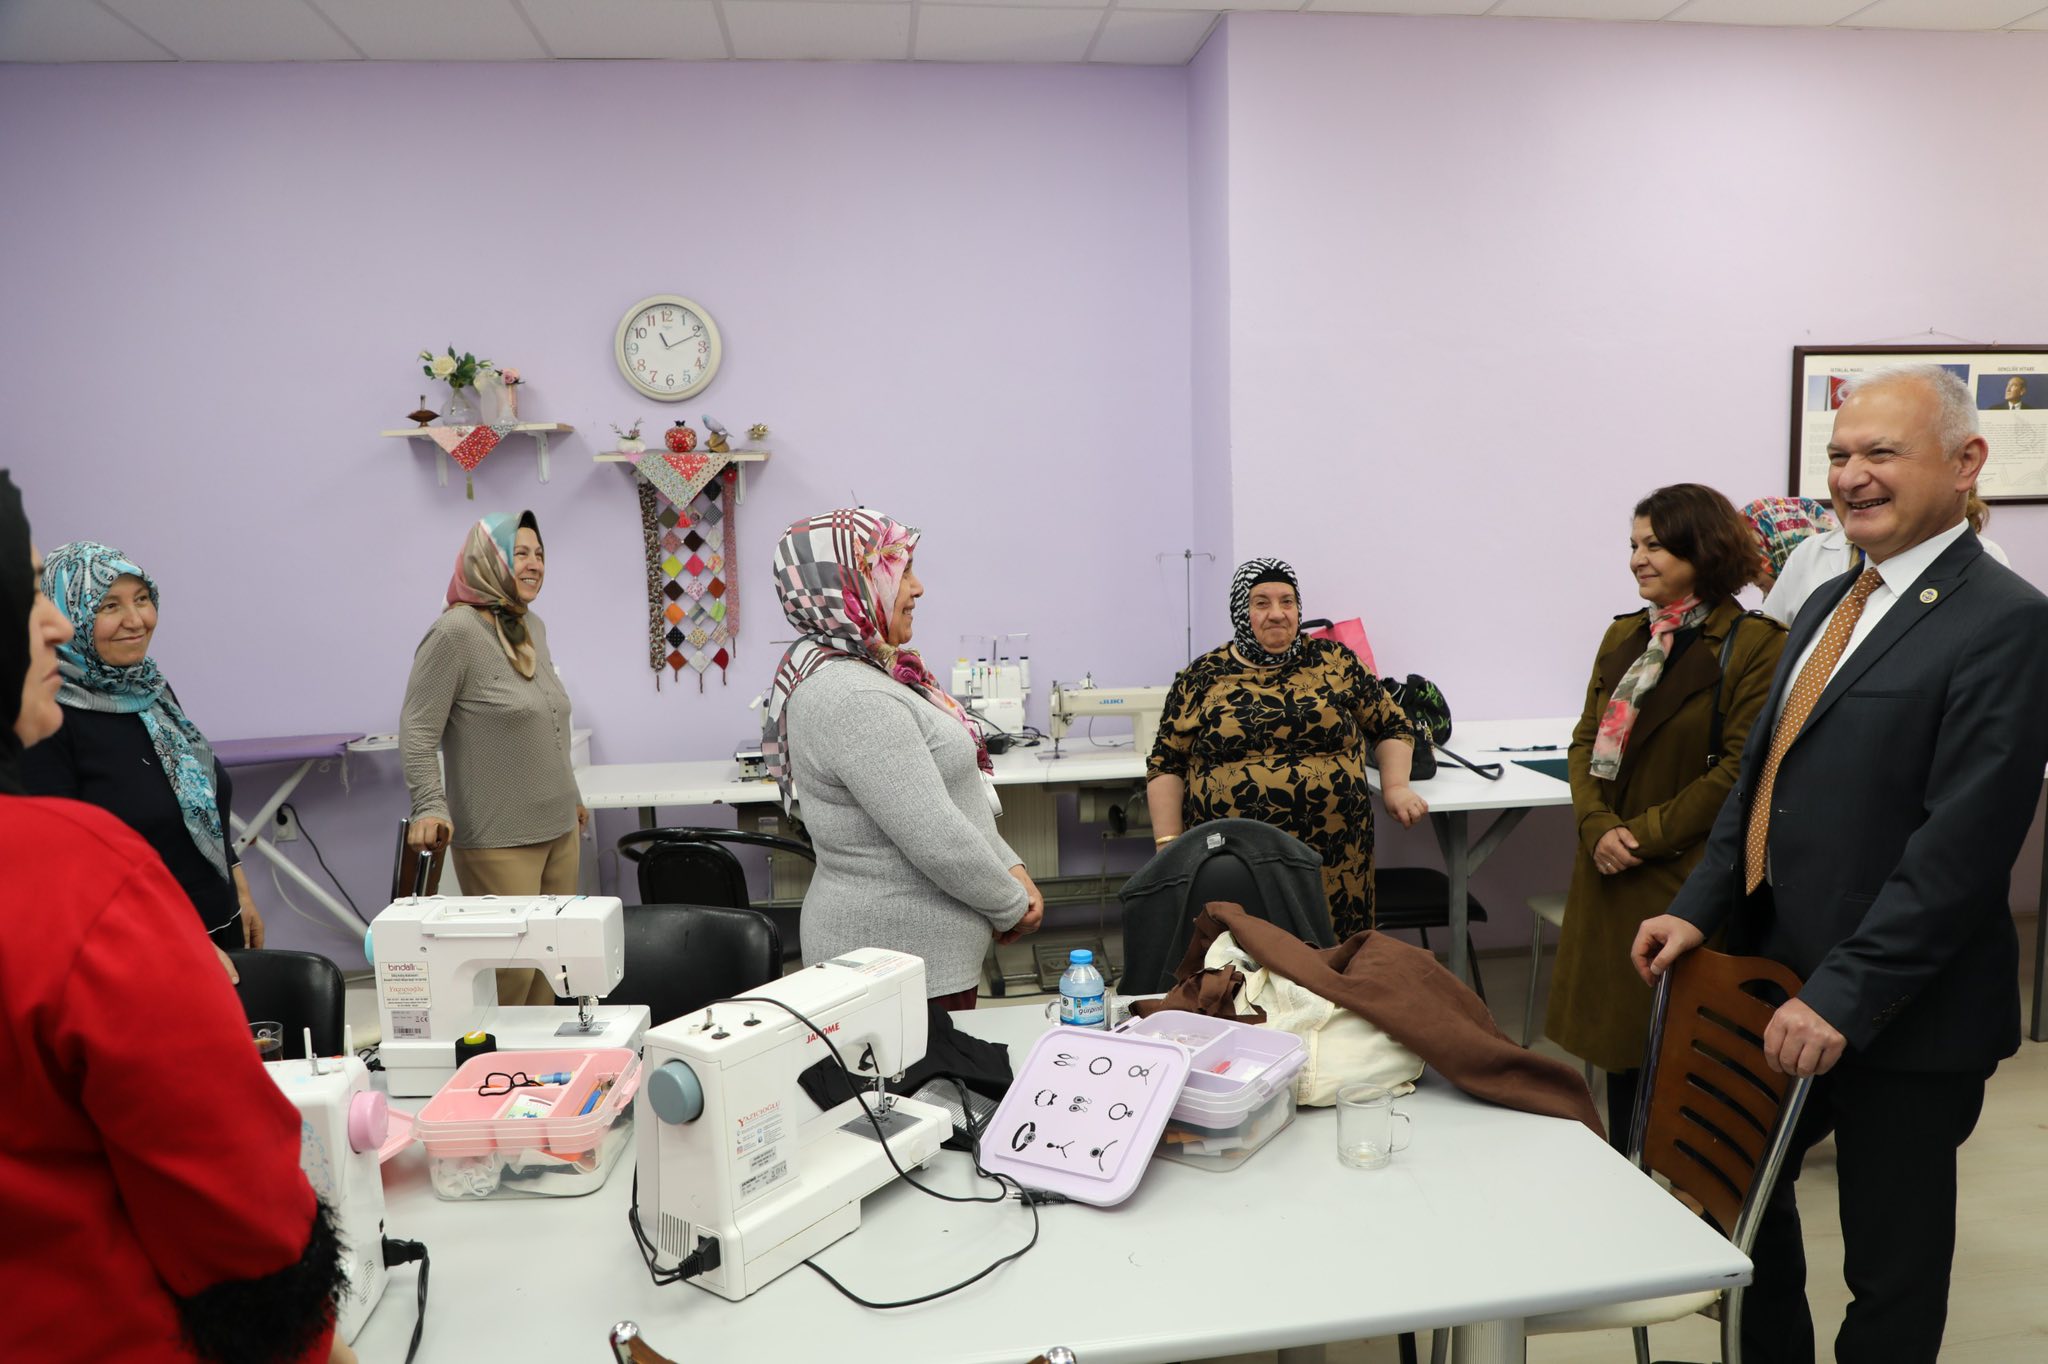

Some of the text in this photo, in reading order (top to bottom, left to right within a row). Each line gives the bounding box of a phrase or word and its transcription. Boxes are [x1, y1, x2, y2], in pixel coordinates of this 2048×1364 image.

[647, 314, 656, 327] 11
[661, 310, 673, 322] 12
[681, 313, 686, 326] 1
[635, 327, 647, 339] 10
[692, 324, 702, 337] 2
[630, 342, 639, 355] 9
[698, 341, 707, 353] 3
[637, 358, 646, 371] 8
[694, 357, 703, 370] 4
[649, 370, 658, 383] 7
[665, 374, 675, 387] 6
[682, 369, 691, 383] 5
